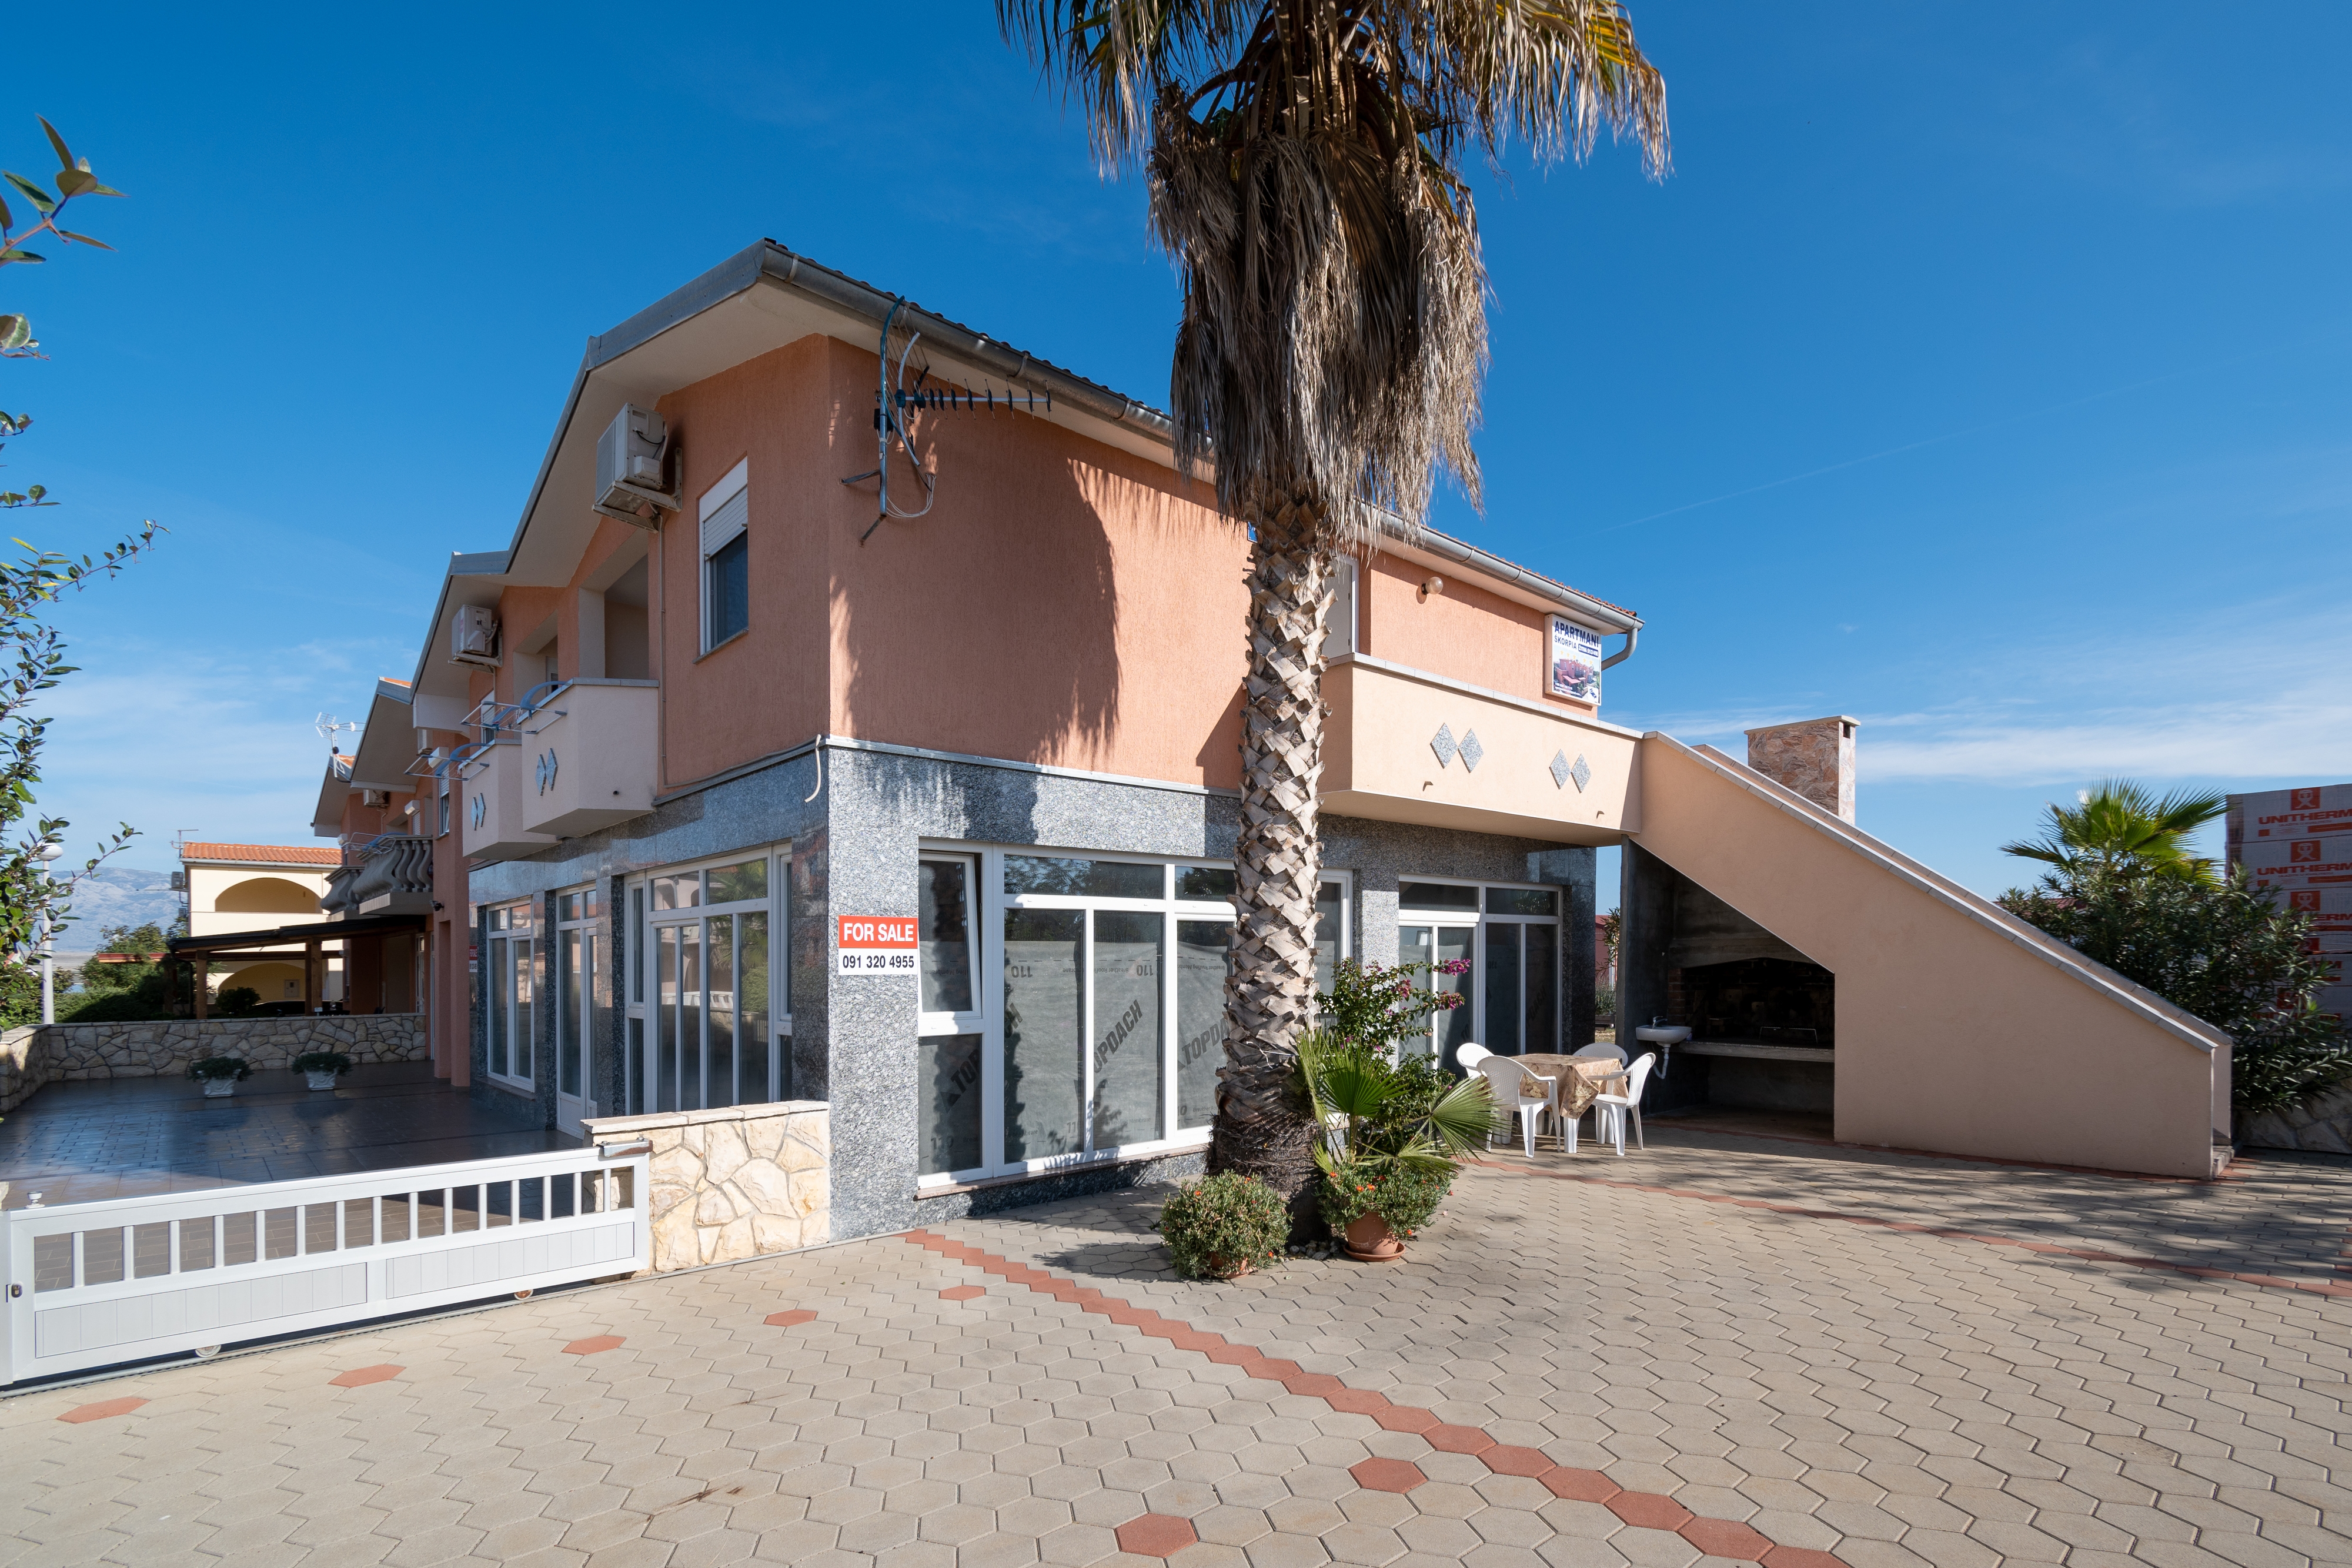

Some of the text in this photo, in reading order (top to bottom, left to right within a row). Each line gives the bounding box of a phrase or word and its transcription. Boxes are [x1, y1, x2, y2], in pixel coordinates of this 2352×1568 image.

[1555, 621, 1599, 648] APARTMANI
[2259, 809, 2352, 824] UNITHERM
[2257, 862, 2352, 875] UNITHERM
[844, 923, 914, 942] FOR SALE
[843, 955, 914, 968] 091 320 4955
[1136, 965, 1154, 977] 110
[1094, 999, 1143, 1074] OPDACH
[1181, 1018, 1230, 1066] TOPDA
